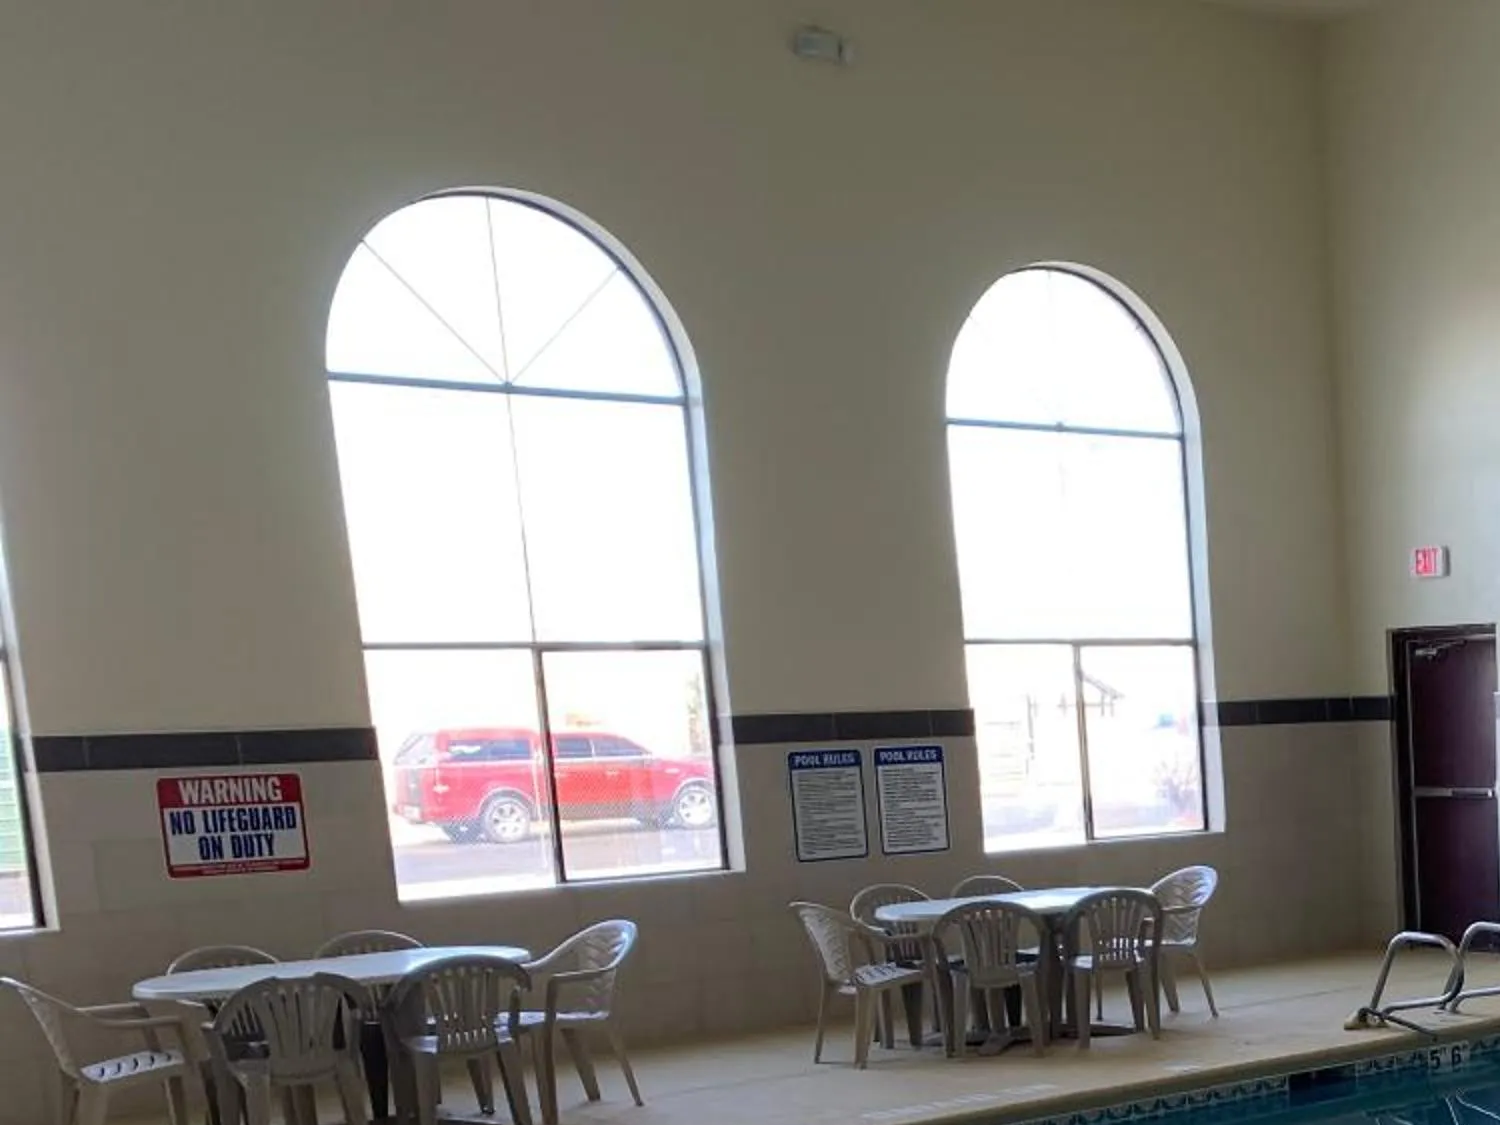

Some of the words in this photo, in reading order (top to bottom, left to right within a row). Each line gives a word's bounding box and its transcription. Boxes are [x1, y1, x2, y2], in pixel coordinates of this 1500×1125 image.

[177, 777, 283, 805] WARNING
[169, 810, 196, 836] NO
[202, 806, 297, 834] LIFEGUARD
[198, 835, 224, 861] ON
[230, 833, 275, 859] DUTY
